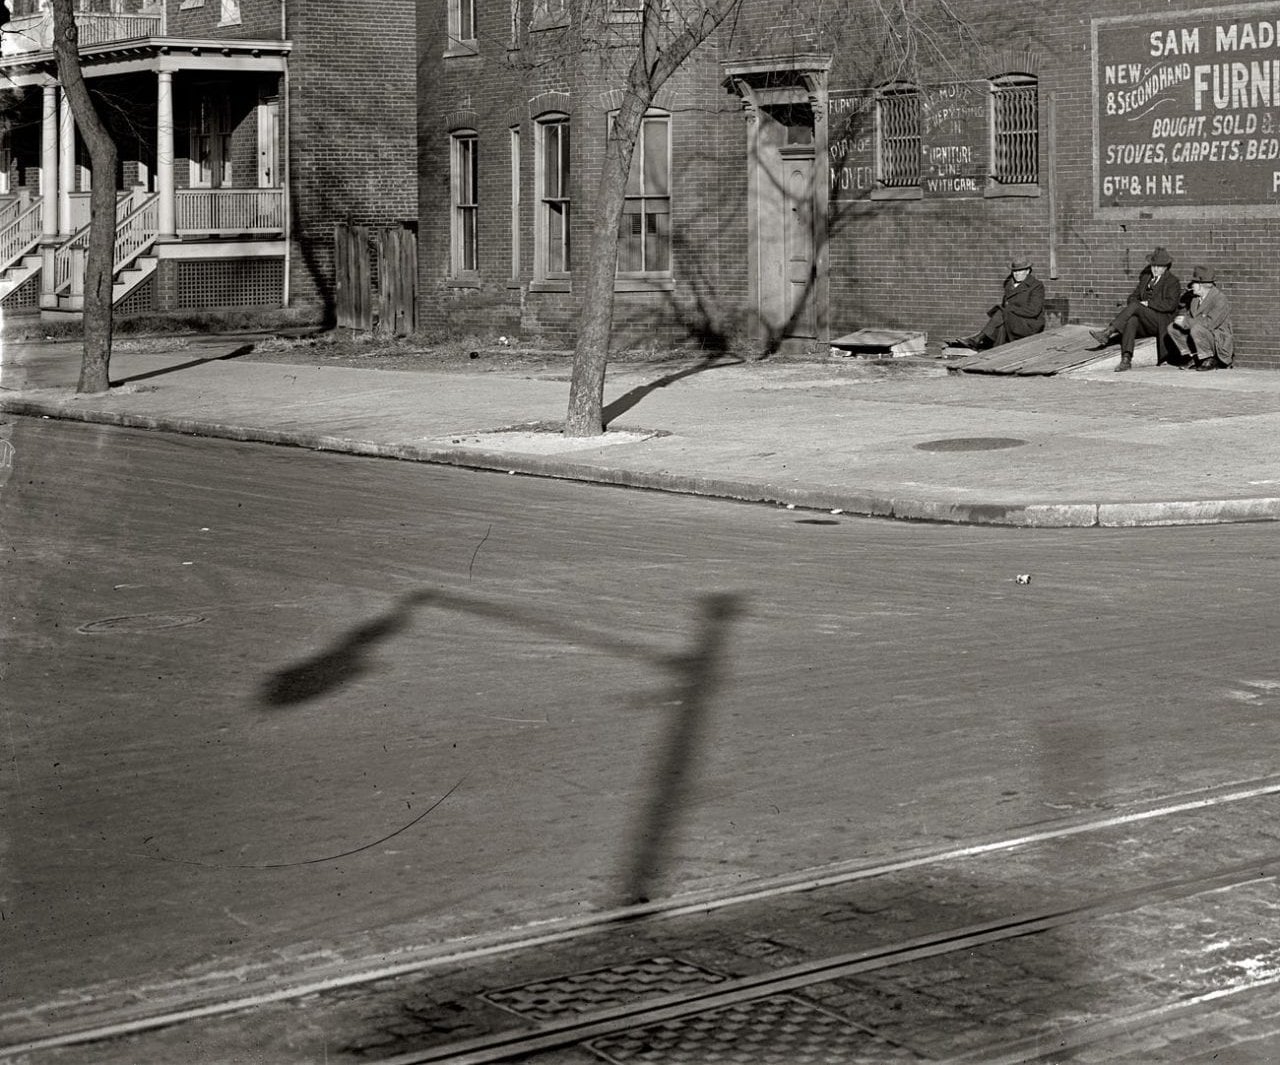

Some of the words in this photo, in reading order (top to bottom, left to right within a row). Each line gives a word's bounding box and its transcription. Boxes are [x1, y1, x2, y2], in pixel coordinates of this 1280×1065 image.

[1150, 27, 1200, 56] SAM
[1105, 63, 1142, 84] NEW
[1152, 115, 1207, 139] BOUGHT,
[1211, 113, 1257, 135] SOLD
[922, 144, 973, 164] FURNITURE
[1106, 143, 1168, 165] STOVES,
[830, 167, 872, 190] MOVED
[938, 163, 961, 176] LINE
[927, 178, 953, 192] WITH
[1103, 176, 1129, 196] 6TH
[1146, 175, 1156, 195] H
